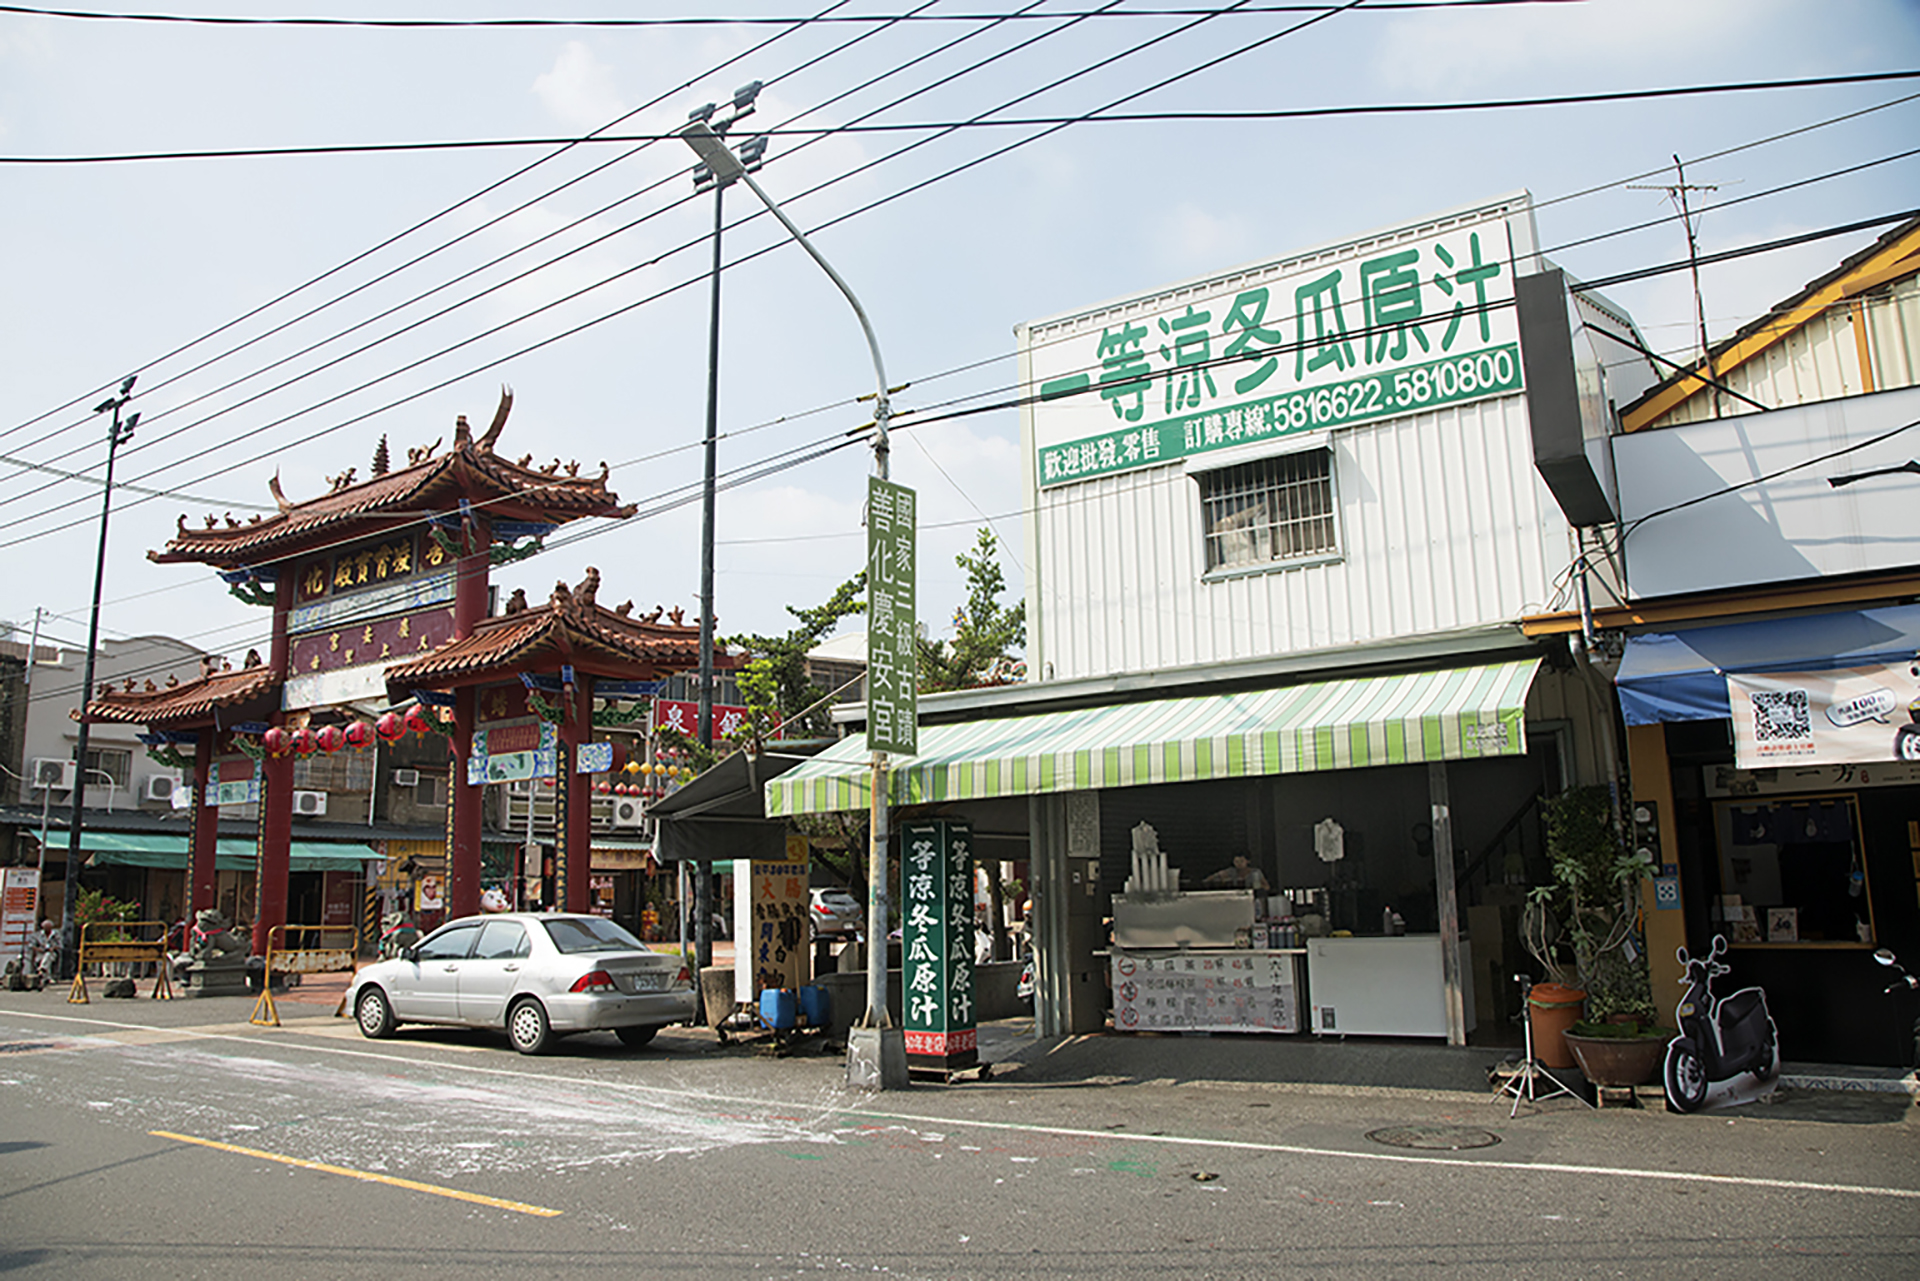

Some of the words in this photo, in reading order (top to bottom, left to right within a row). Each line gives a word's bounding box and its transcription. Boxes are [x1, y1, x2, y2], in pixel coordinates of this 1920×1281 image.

[1041, 232, 1500, 422] 一等涼冬瓜原汁
[870, 486, 895, 745] 善化慶安宮
[908, 825, 939, 1027] 一等涼冬瓜原汁
[949, 825, 972, 1024] 一等涼冬瓜原汁
